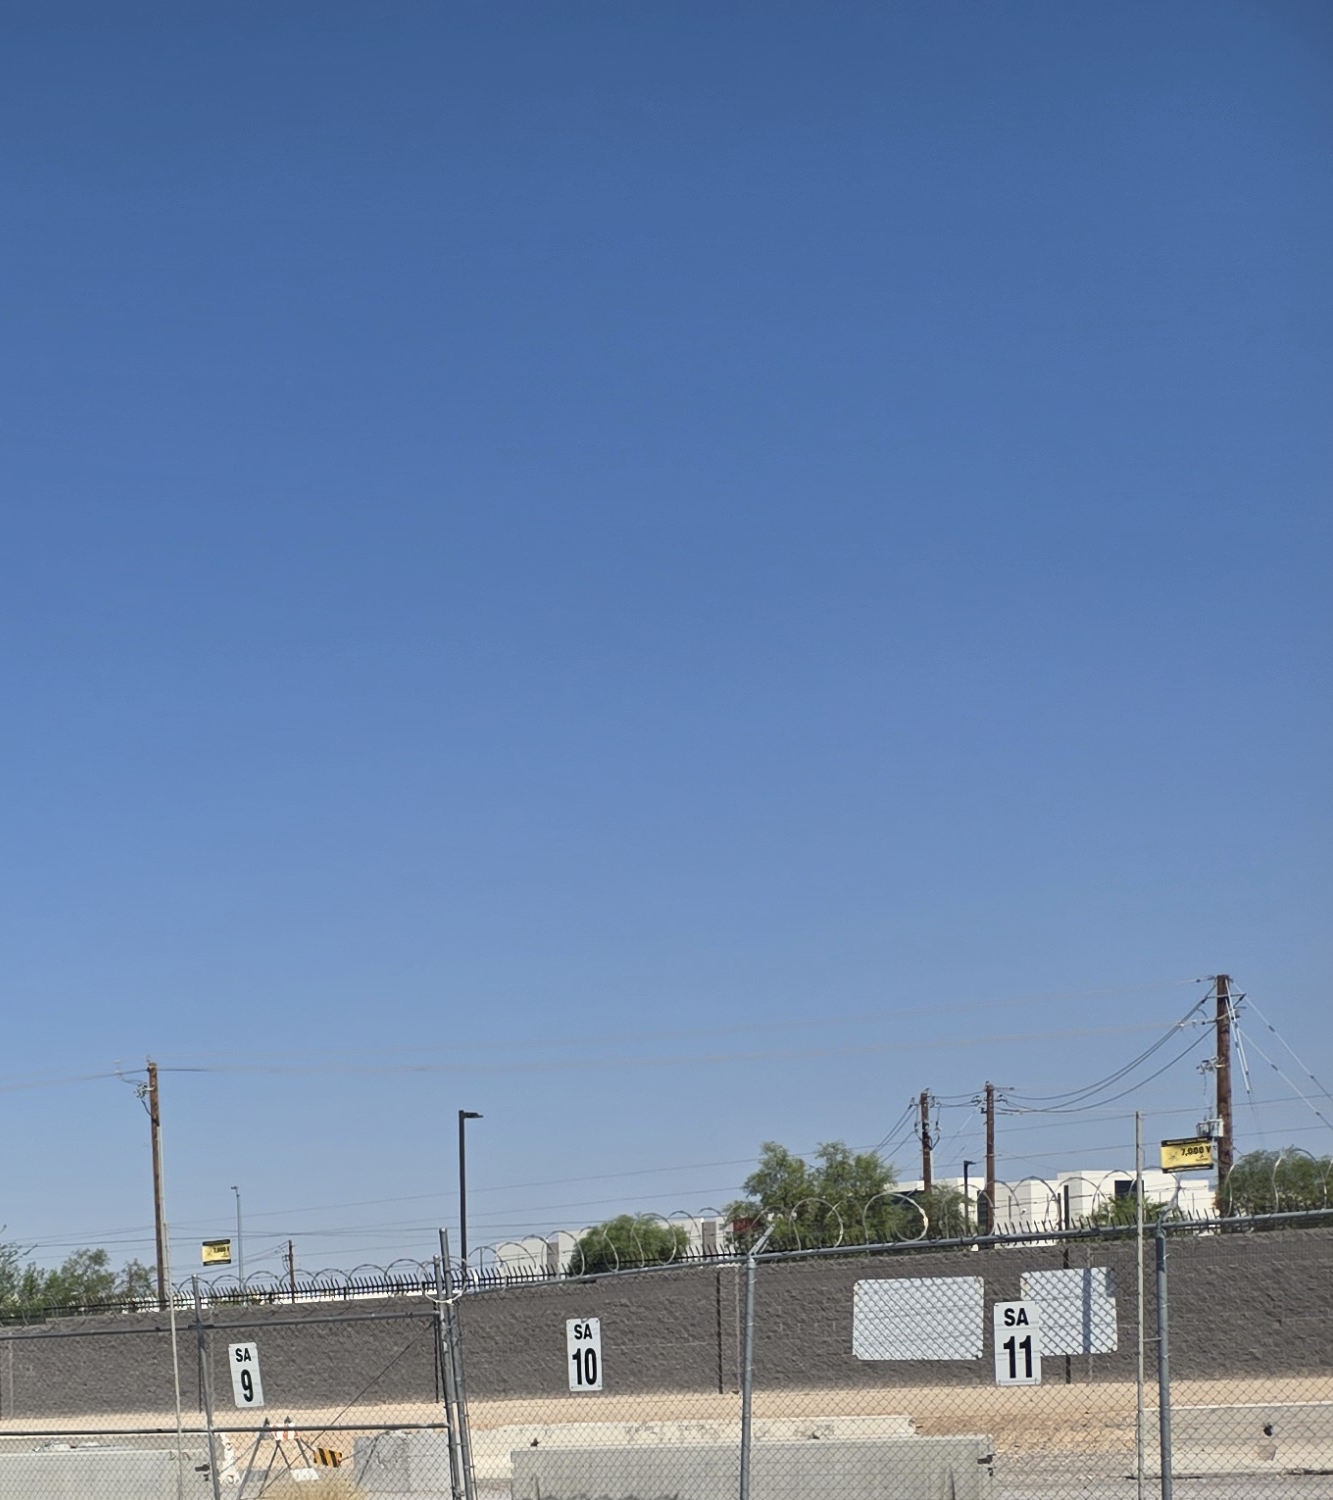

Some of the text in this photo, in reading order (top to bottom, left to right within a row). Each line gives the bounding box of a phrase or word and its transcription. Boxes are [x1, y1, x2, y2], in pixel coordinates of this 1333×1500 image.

[1004, 1307, 1029, 1327] SA
[573, 1323, 593, 1340] SA
[235, 1347, 252, 1363] SA
[571, 1347, 598, 1386] 10
[1003, 1334, 1033, 1379] 11
[240, 1369, 254, 1403] 9
